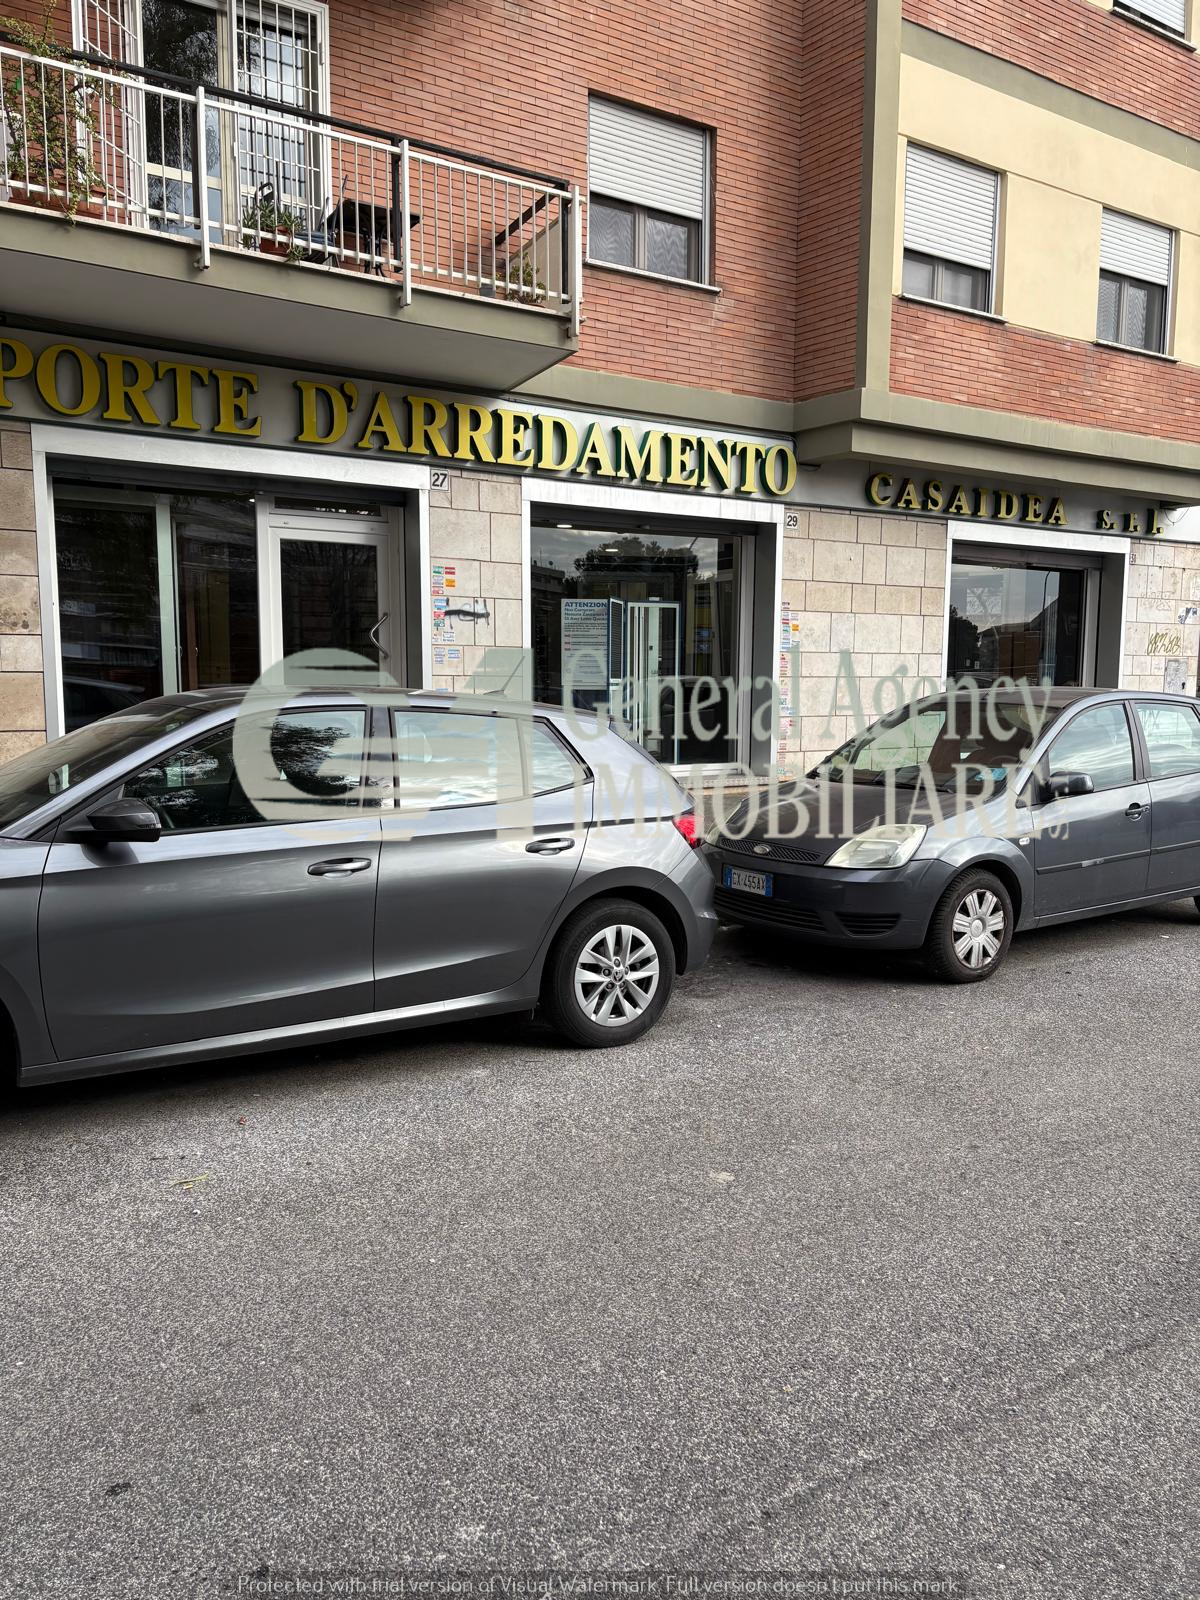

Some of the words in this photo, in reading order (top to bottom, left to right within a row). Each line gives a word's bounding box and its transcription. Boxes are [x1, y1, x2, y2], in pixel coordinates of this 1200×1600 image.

[0, 337, 262, 436] PORTE
[295, 379, 798, 496] D'ARREDAMENTO
[432, 472, 448, 487] 27
[866, 471, 1068, 525] CASAIDEA
[787, 514, 798, 527] 29
